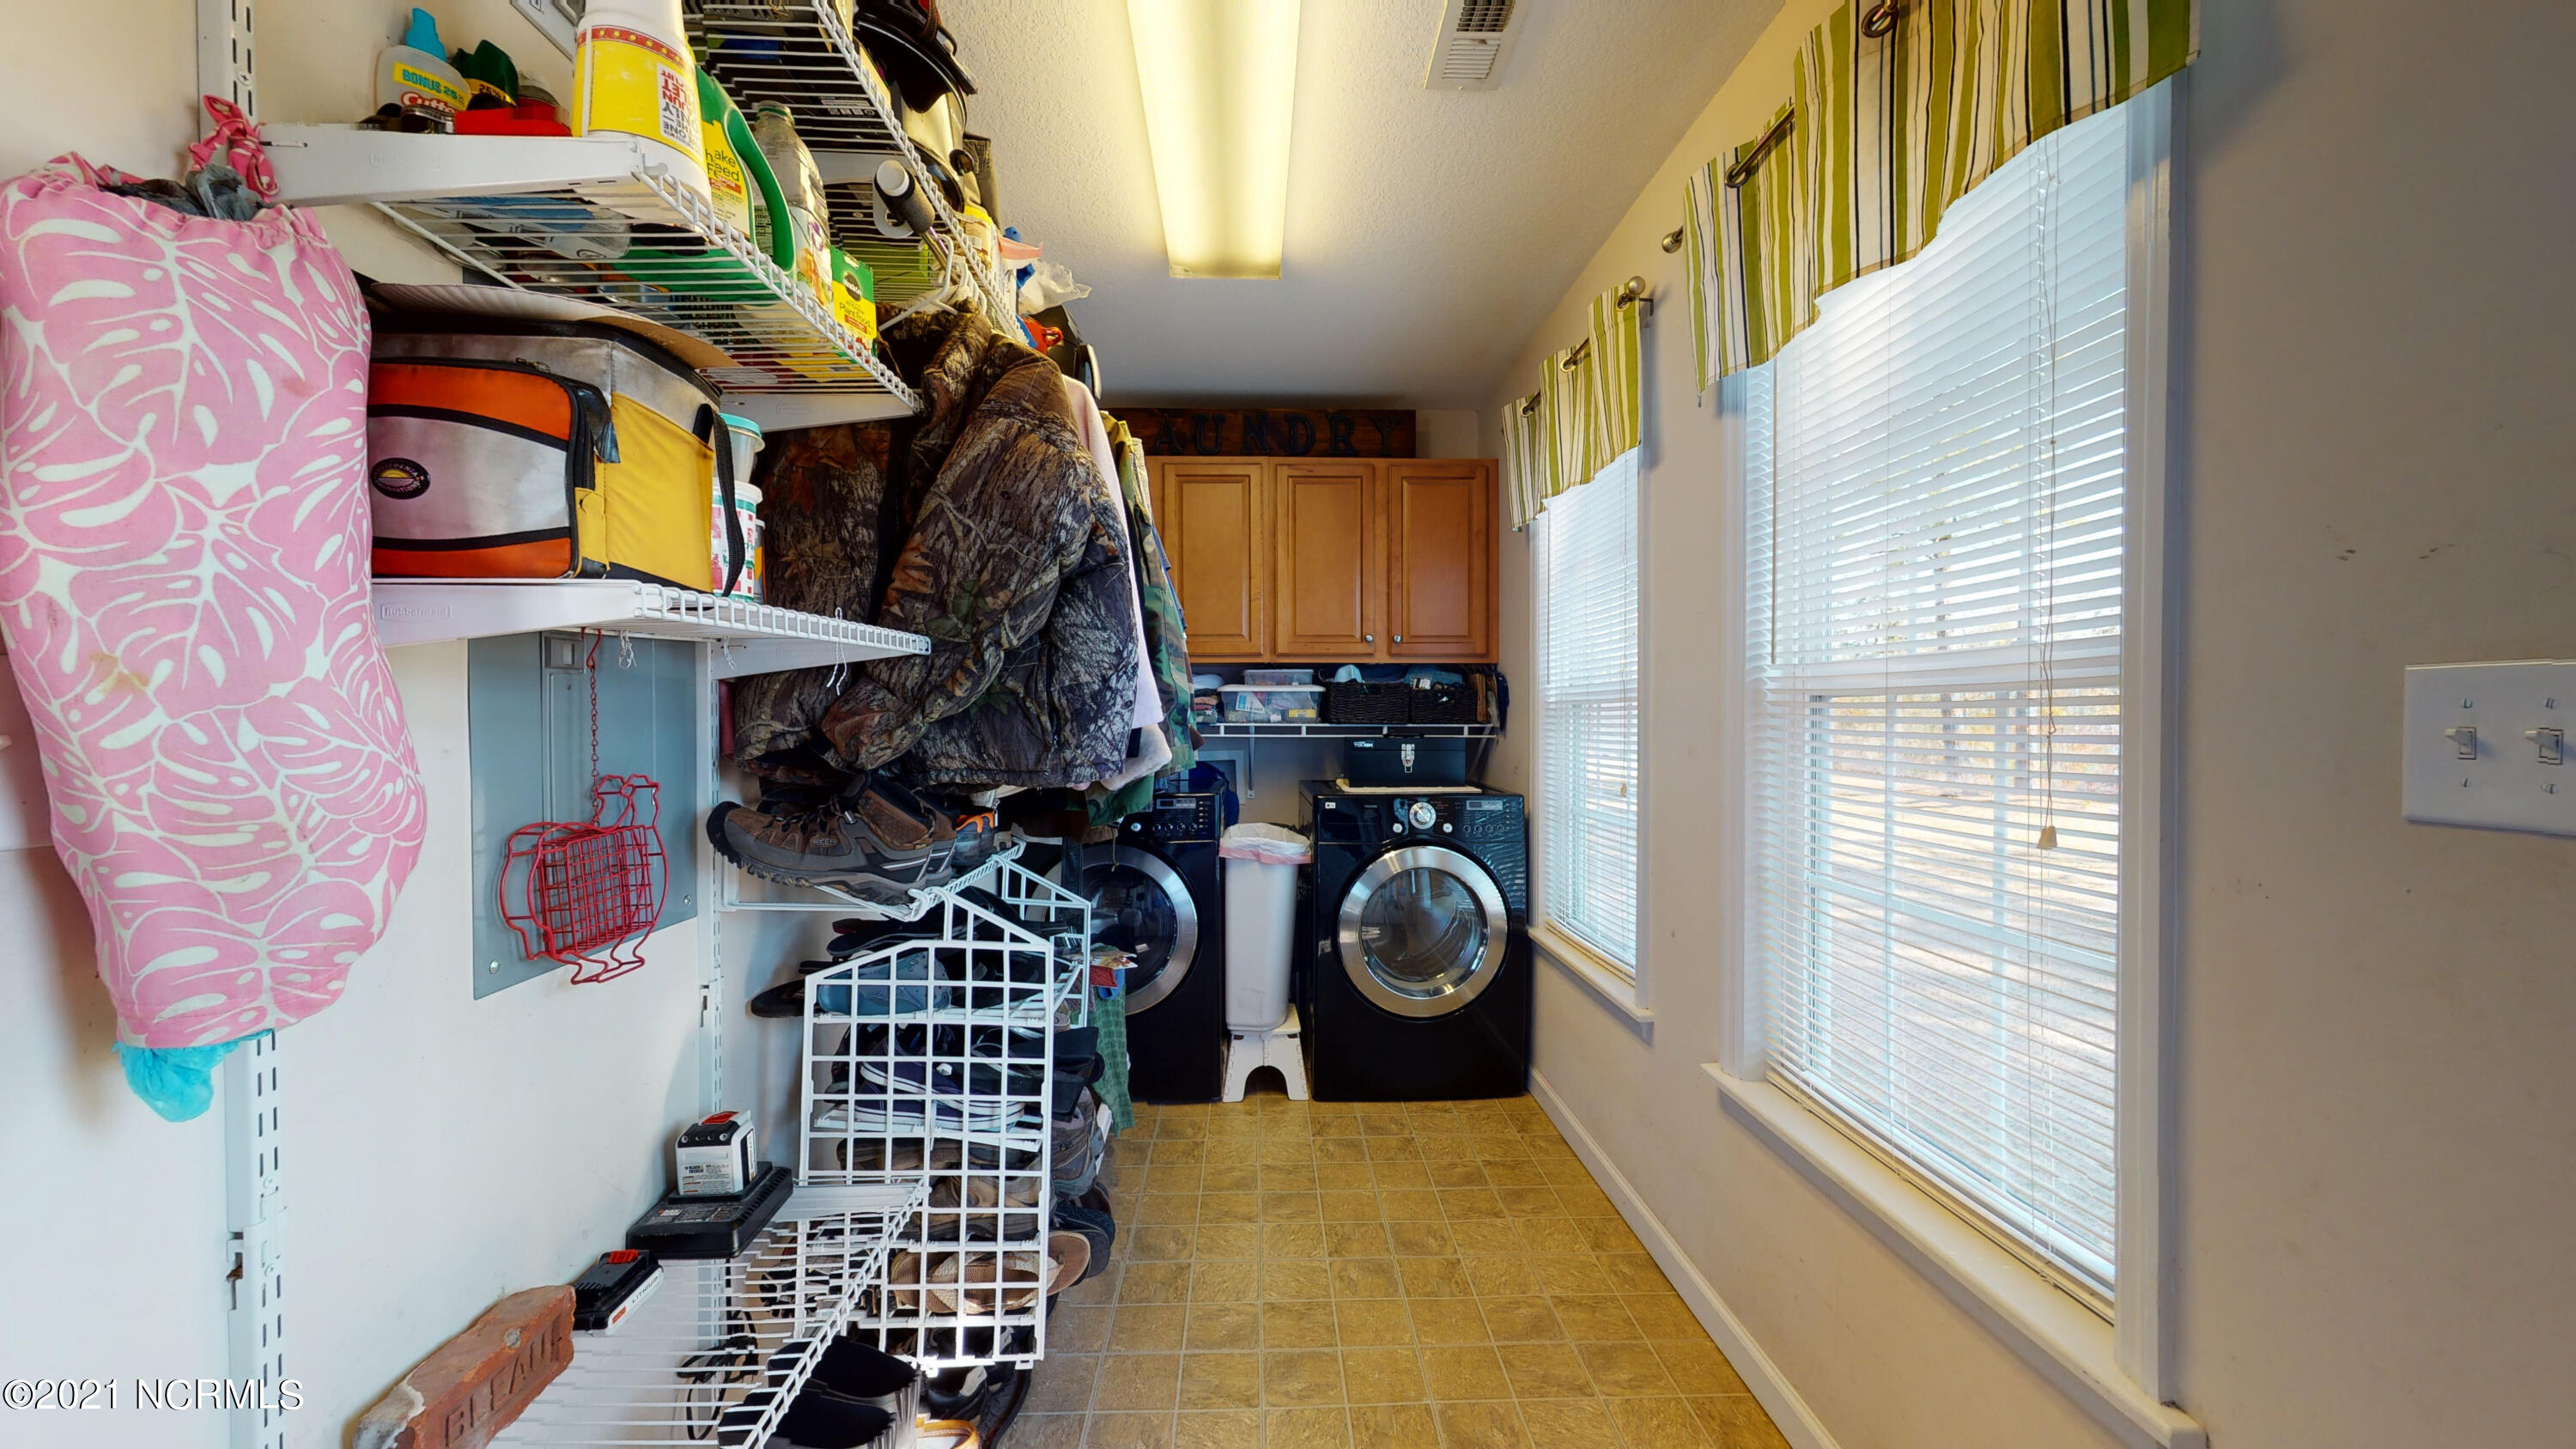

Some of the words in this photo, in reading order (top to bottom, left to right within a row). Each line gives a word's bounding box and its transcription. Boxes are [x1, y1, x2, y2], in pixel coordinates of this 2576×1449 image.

[403, 69, 441, 94] BONUS
[401, 92, 455, 113] Cutte
[705, 149, 736, 167] hake
[1152, 413, 1400, 455] AUNDRY
